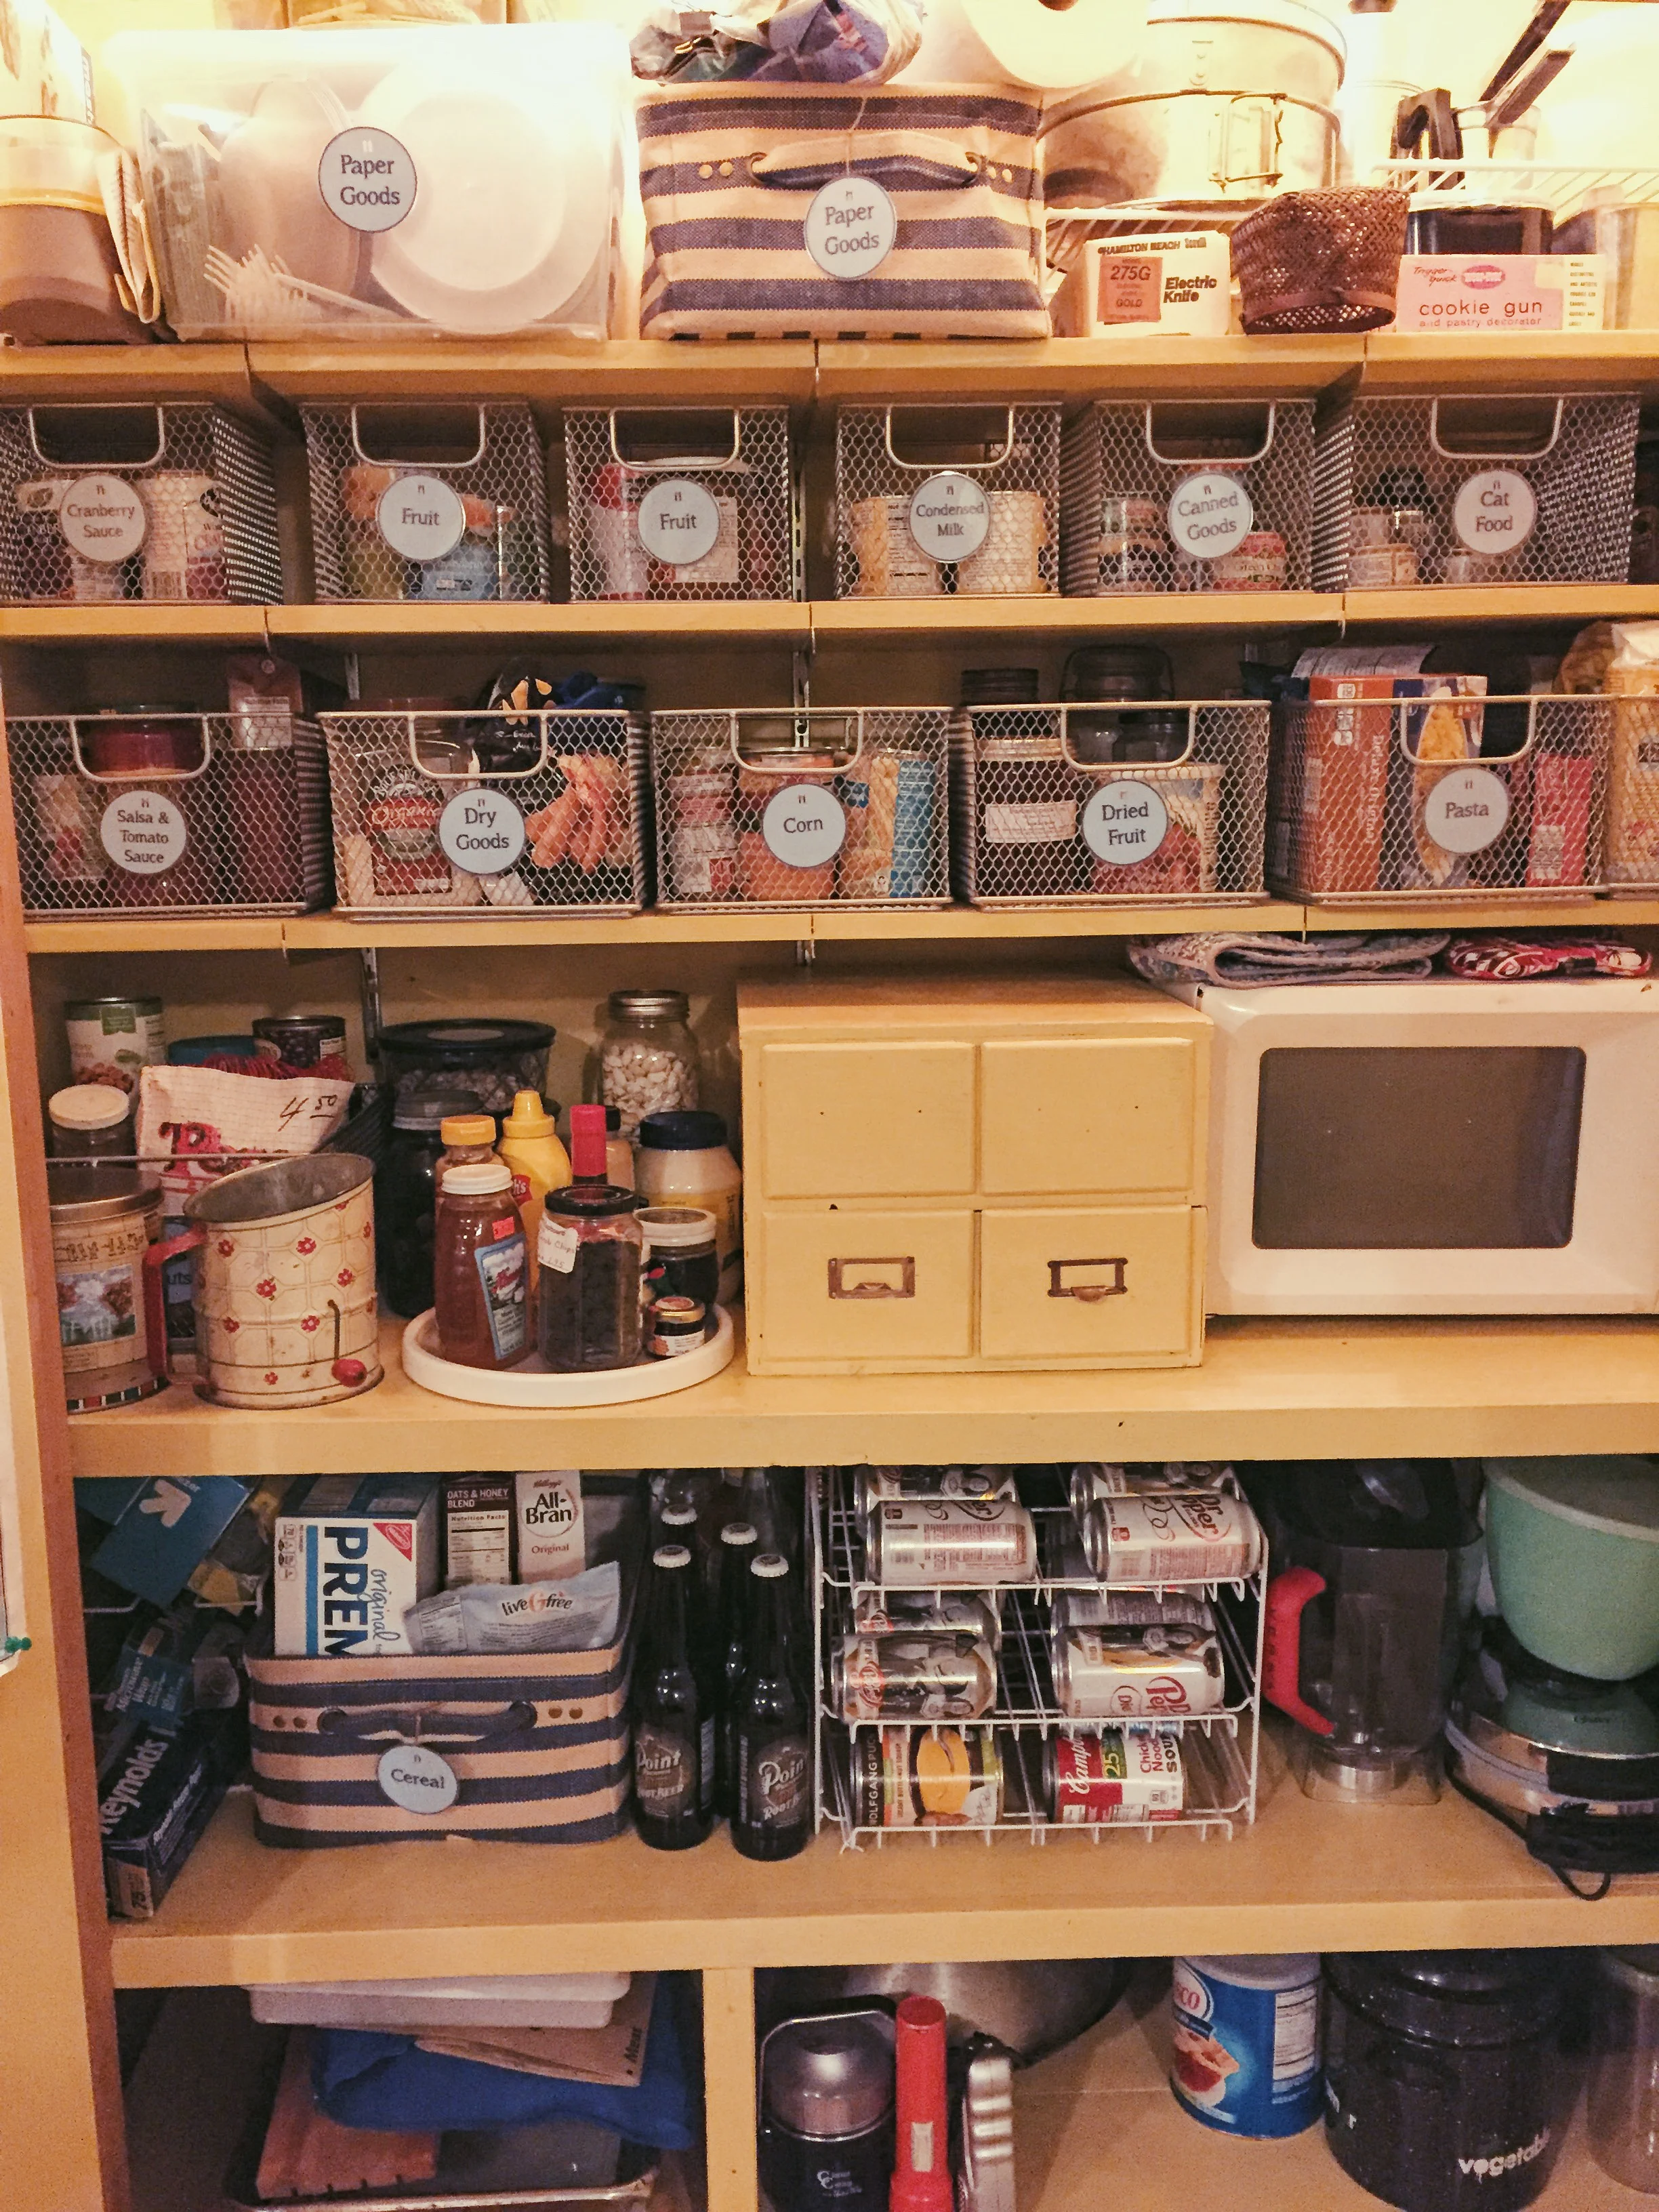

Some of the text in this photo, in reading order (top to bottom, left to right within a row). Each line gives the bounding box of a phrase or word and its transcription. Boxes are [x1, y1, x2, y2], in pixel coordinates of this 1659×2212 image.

[341, 155, 395, 180] Paper
[340, 186, 401, 205] Goods
[825, 205, 874, 228] Paper
[824, 231, 880, 255] Goods
[1103, 243, 1148, 255] HAMILTON
[1150, 241, 1181, 251] BEACH
[1110, 265, 1151, 281] 275G
[1165, 275, 1217, 289] Electric
[1116, 298, 1143, 308] GOLD
[1163, 291, 1200, 304] Knife
[1419, 299, 1543, 317] cookie gun
[1419, 318, 1542, 328] and pastry decorator
[1177, 490, 1240, 516] Canned
[1480, 490, 1510, 507] Cat
[66, 503, 135, 519] Cranberry
[401, 508, 440, 526] Fruit
[916, 503, 985, 517] Condensed
[659, 513, 697, 530] Fruit
[937, 522, 964, 536] Milk
[1187, 518, 1237, 540] Goods
[1475, 515, 1513, 532] Food
[83, 525, 123, 538] Sauce
[117, 809, 169, 824] Salsa &
[464, 807, 497, 827] Dry
[1101, 802, 1149, 821] Dried
[1445, 801, 1490, 819] Pasta
[783, 817, 824, 834] Corn
[119, 829, 169, 844] Tomato
[455, 833, 510, 851] Goods
[1107, 828, 1147, 846] Fruit
[124, 849, 164, 863] Sauce
[447, 1488, 509, 1500] OATS & HONEY
[535, 1492, 567, 1509] All-
[447, 1498, 475, 1509] BLEND
[451, 1514, 485, 1522] Nutrition
[525, 1507, 572, 1525] Bran
[531, 1544, 570, 1555] Original
[356, 1569, 401, 1641] original
[1103, 1753, 1122, 1778] 25
[391, 1768, 445, 1789] Cereal
[758, 1760, 804, 1795] Poin
